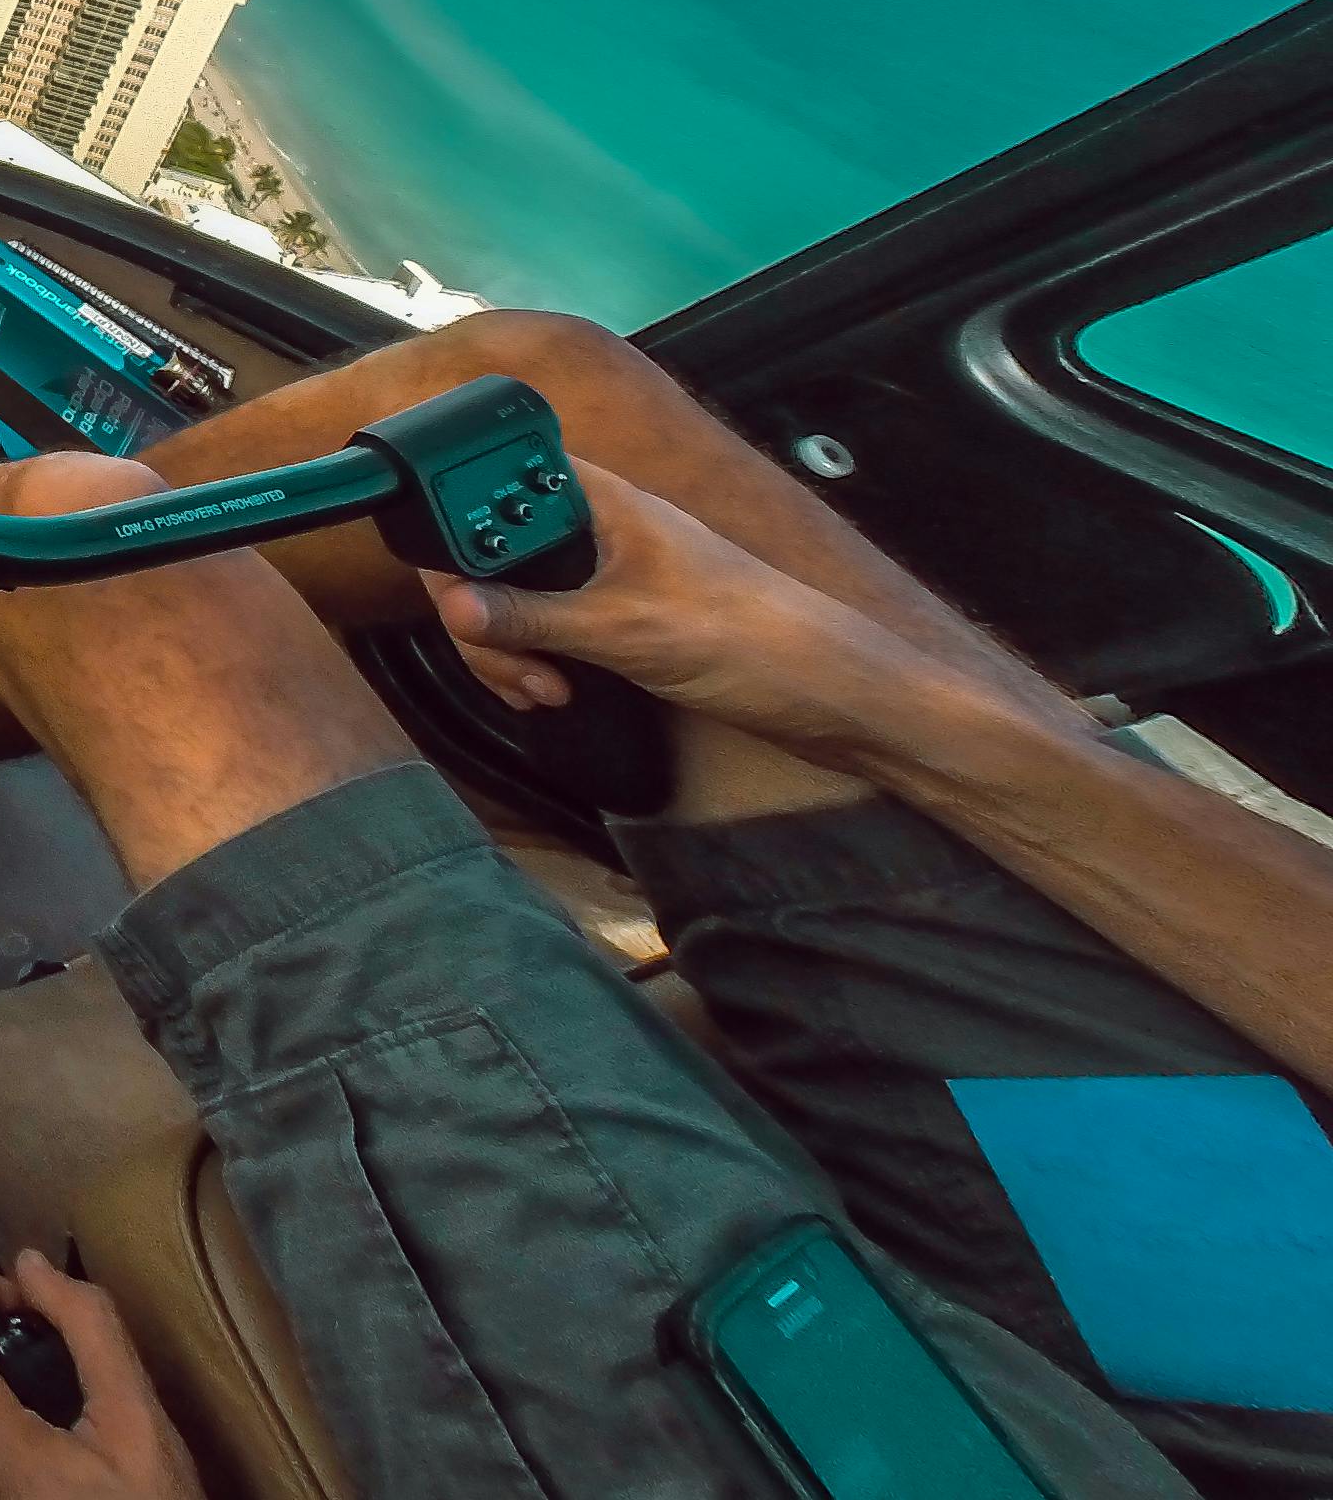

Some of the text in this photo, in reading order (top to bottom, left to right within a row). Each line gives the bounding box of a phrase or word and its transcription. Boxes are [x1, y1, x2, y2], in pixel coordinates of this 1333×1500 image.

[5, 263, 90, 327] Handbook
[115, 489, 286, 538] LOW-G PUSHOVERS PROHIBITED
